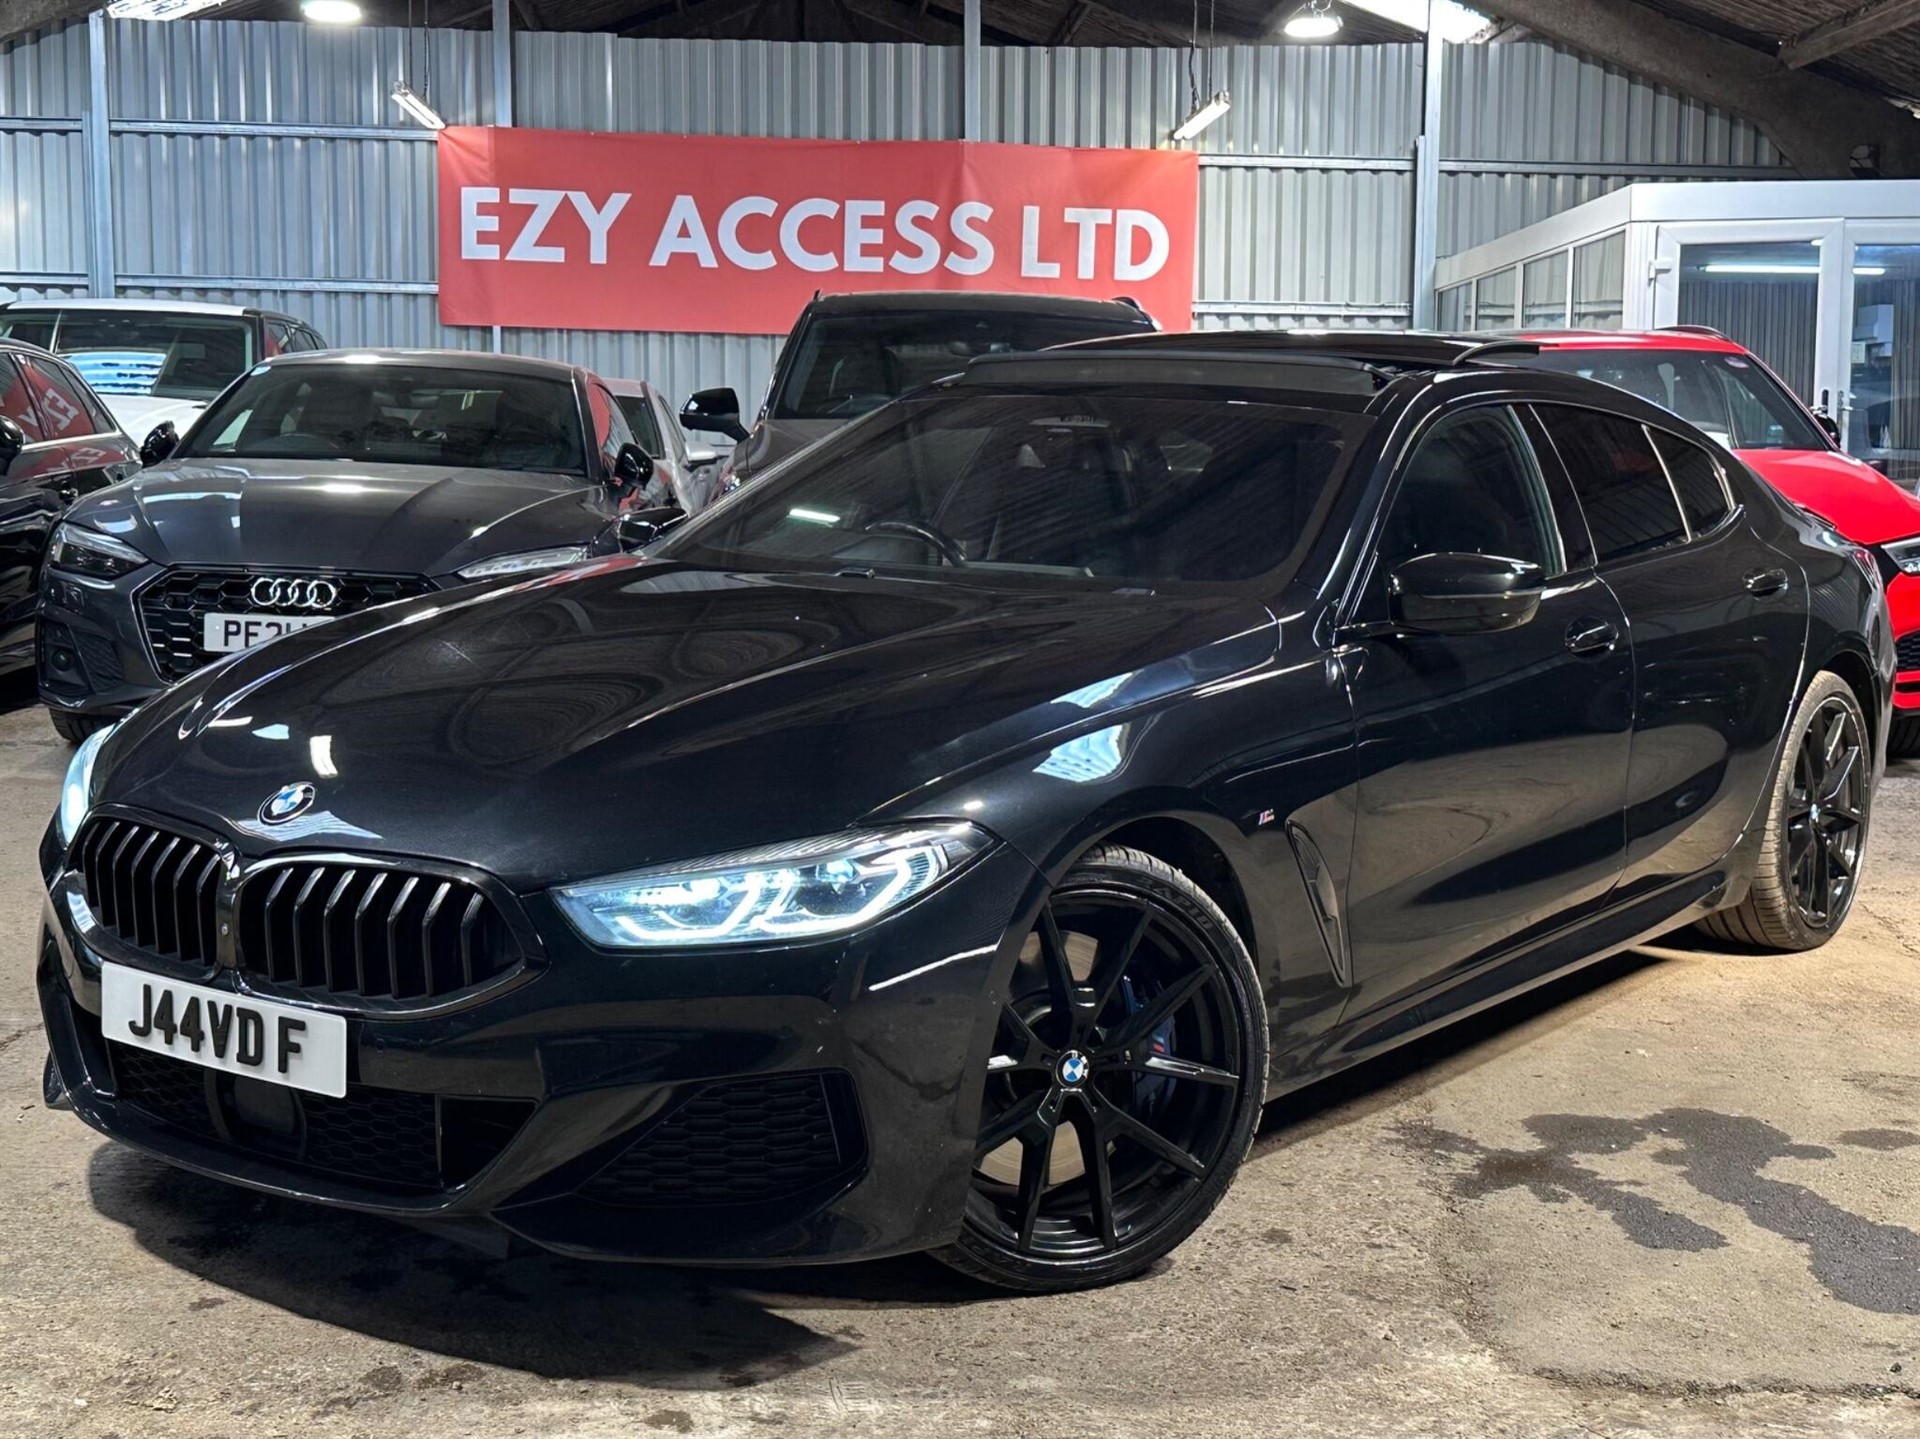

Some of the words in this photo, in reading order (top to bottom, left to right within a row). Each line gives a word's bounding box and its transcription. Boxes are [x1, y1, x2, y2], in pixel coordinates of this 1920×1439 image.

[460, 186, 632, 265] EZY
[649, 195, 995, 277] ACCESS
[1020, 205, 1170, 281] LTD
[128, 984, 264, 1067] J44VD
[278, 1015, 306, 1074] F
